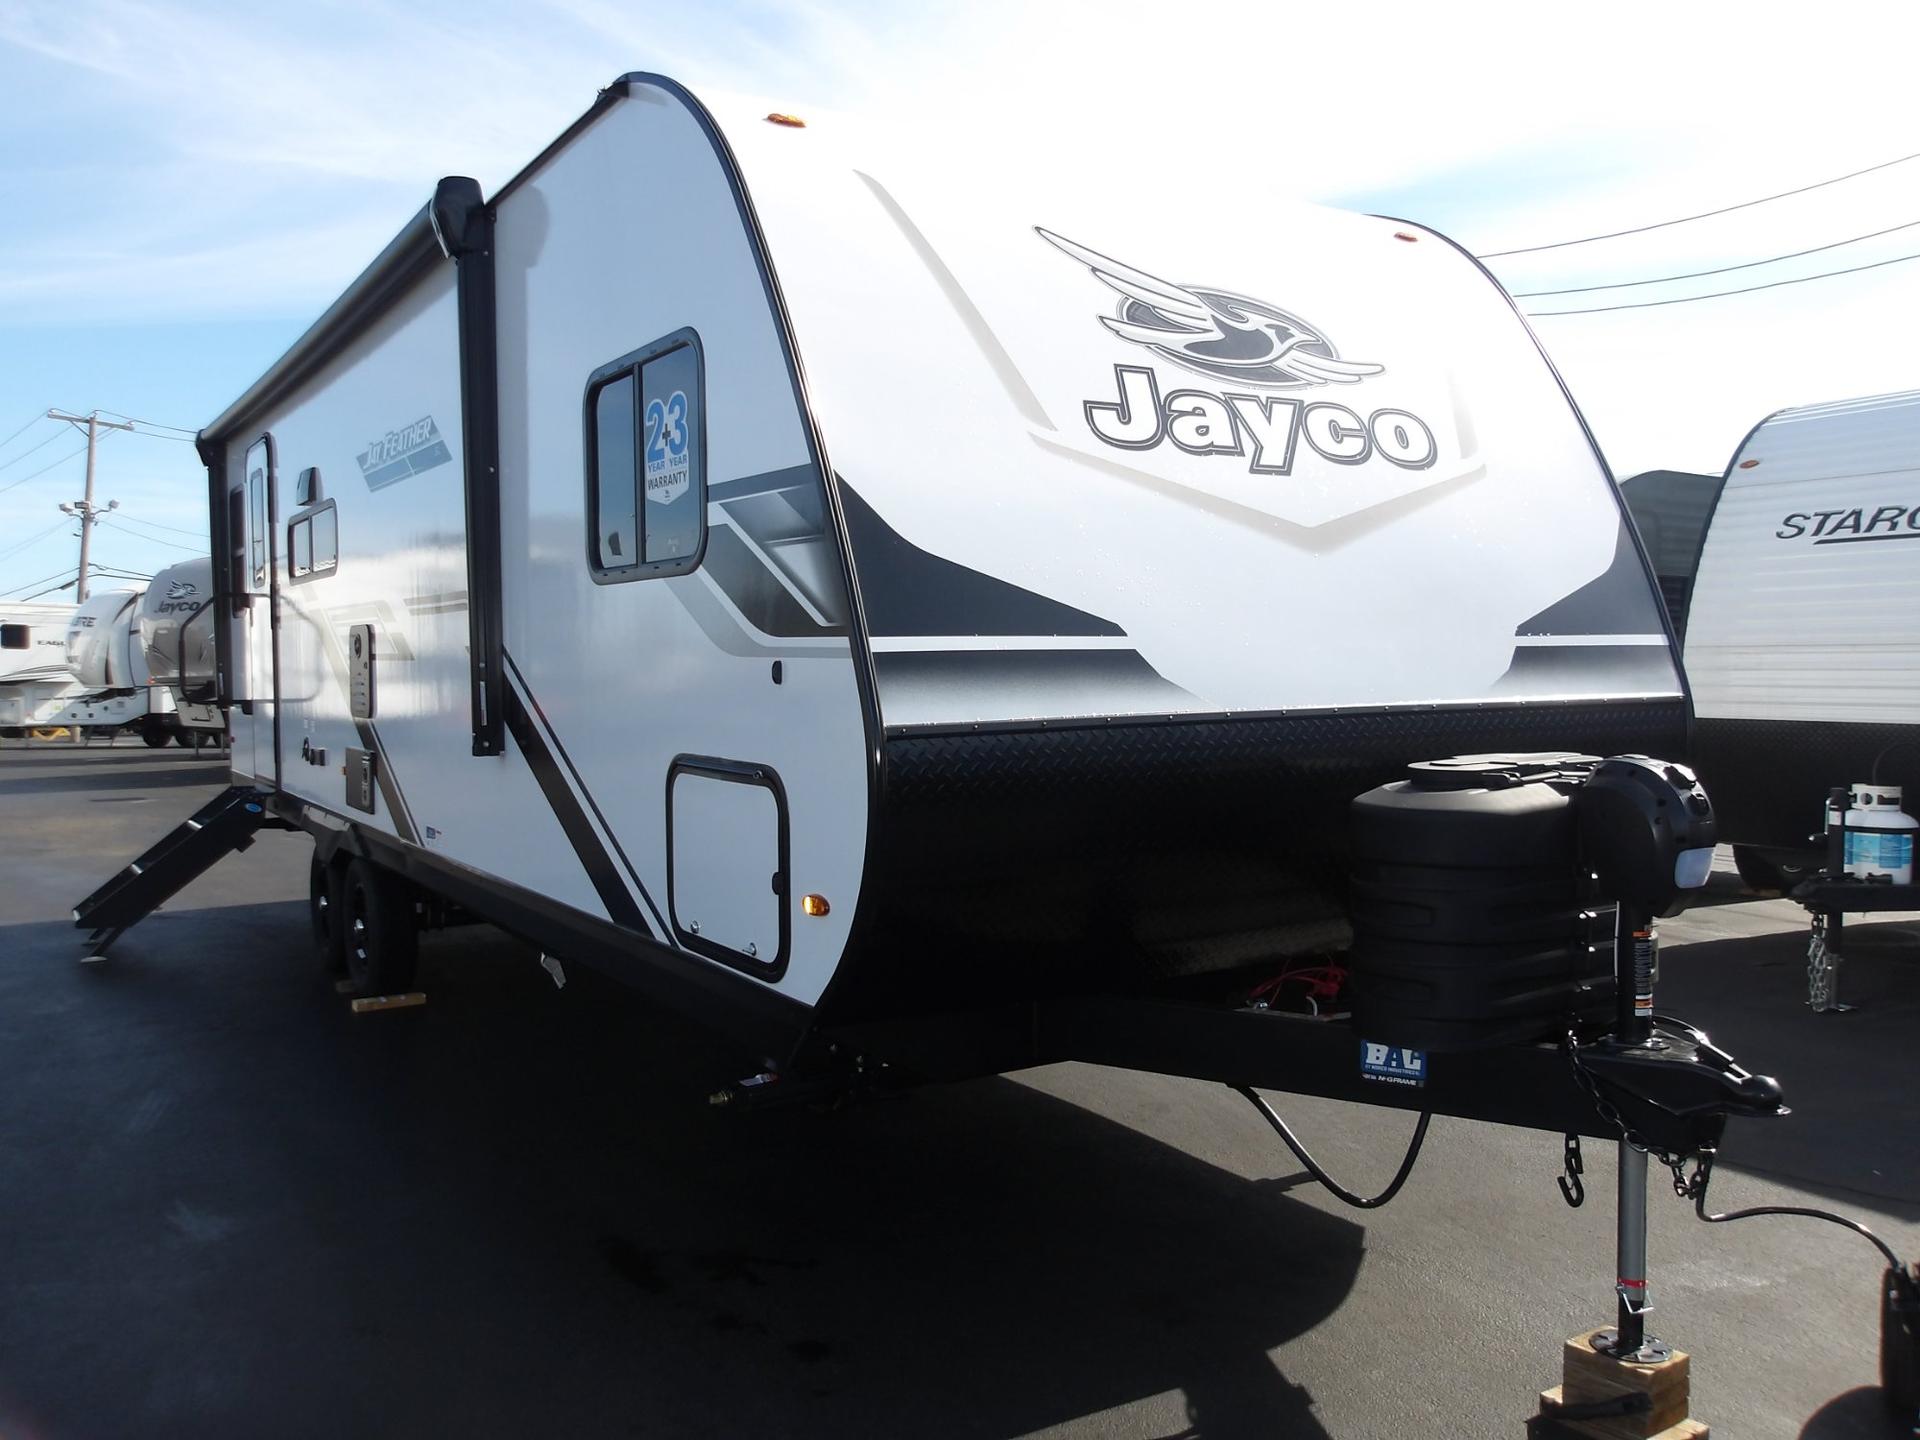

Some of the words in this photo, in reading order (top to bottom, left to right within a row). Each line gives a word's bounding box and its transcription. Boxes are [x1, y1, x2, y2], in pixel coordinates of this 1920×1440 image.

[1083, 363, 1438, 476] Jayco
[383, 416, 433, 461] FEATHER
[647, 460, 666, 474] YEAR
[669, 455, 688, 469] YEAR
[647, 471, 688, 491] WARRANTY
[153, 600, 202, 615] Jayco
[1366, 1043, 1421, 1070] BAL
